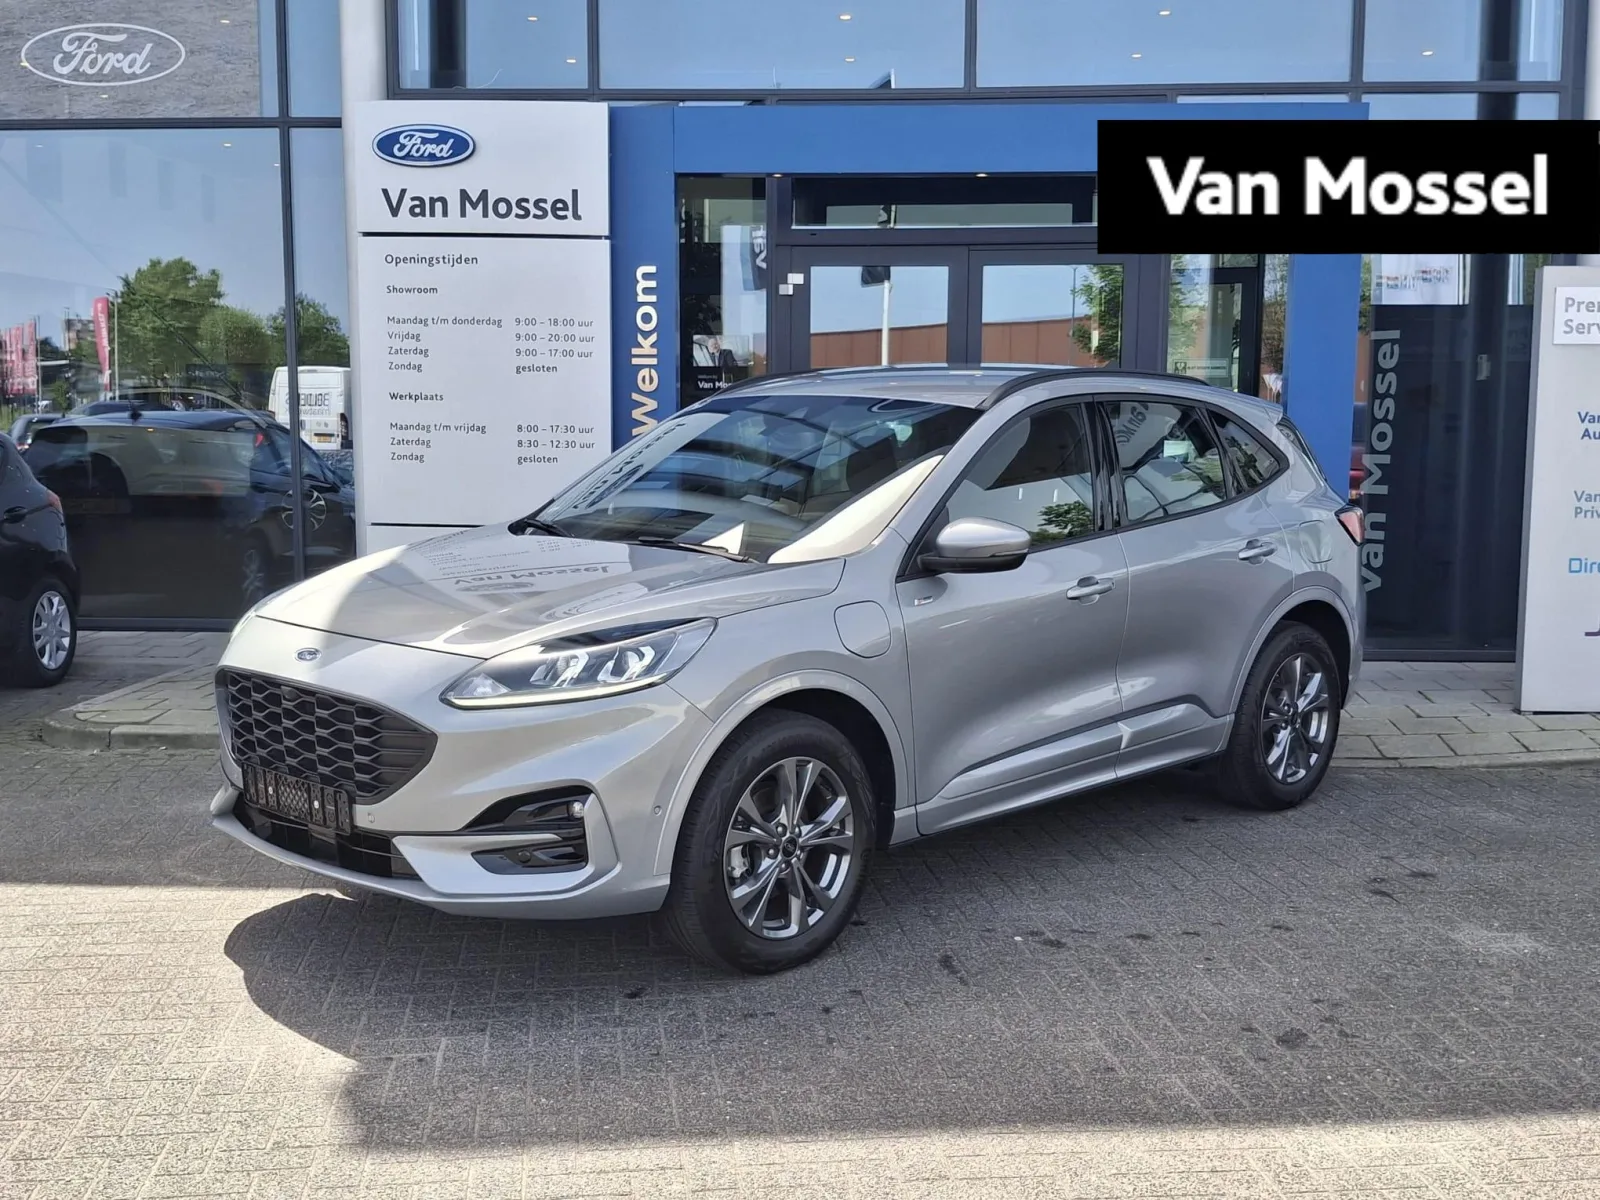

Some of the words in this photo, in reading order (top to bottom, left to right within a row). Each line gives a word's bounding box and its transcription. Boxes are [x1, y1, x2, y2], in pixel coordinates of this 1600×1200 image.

[53, 32, 153, 75] Ford
[393, 131, 455, 157] Ford
[381, 188, 449, 218] Van
[459, 189, 582, 220] Mossel
[384, 254, 479, 267] Openingstijden
[386, 285, 438, 294] Showroom
[1564, 297, 1600, 313] Pre
[387, 316, 429, 327] Maandag
[432, 316, 449, 325] t/m
[451, 317, 503, 329] donderdag
[515, 317, 537, 327] 9:00
[548, 318, 575, 327] 18:00
[577, 320, 594, 328] uur
[387, 331, 421, 343] Vrijdag
[515, 332, 537, 342] 9:00
[548, 333, 576, 343] 20:00
[388, 346, 429, 358] Zaterdag
[515, 348, 538, 357] 9:00
[548, 348, 575, 358] 17:00
[631, 265, 659, 437] Welkom
[388, 361, 423, 373] Zondag
[515, 364, 558, 375] gesloten
[389, 392, 444, 403] Werkplaats
[1360, 329, 1400, 495] Mossel
[390, 422, 432, 434] Maandag
[434, 423, 451, 432] t/m
[454, 423, 487, 435] vrijdag
[517, 424, 539, 433] 8:00
[550, 425, 575, 434] 17:30
[390, 437, 431, 449] Zaterdag
[517, 439, 539, 448] 8:30
[550, 440, 576, 449] 12:30
[391, 452, 425, 464] Zondag
[517, 454, 559, 466] gesloten
[1568, 557, 1600, 574] Dir
